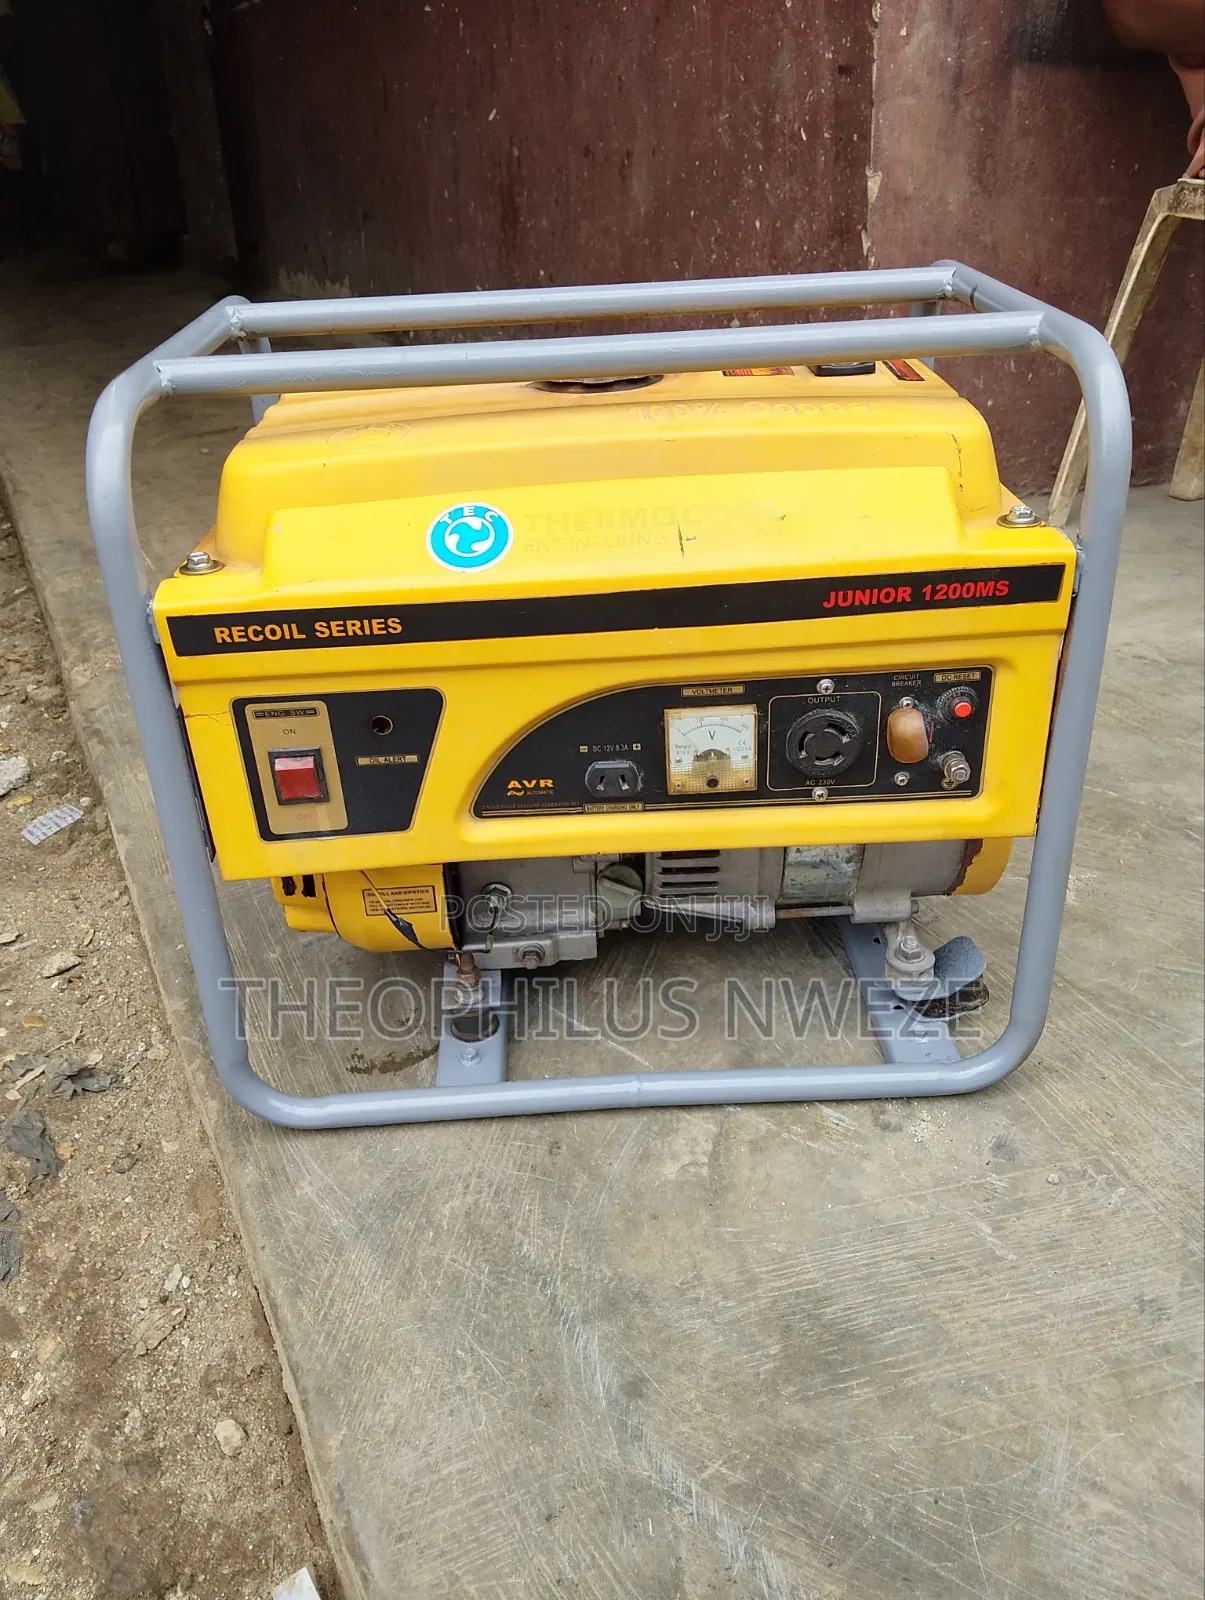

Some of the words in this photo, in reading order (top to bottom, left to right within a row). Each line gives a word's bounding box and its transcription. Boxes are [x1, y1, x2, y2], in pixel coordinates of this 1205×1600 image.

[439, 505, 499, 525] TEC
[822, 586, 912, 608] JUNIOR
[921, 580, 1010, 600] 1200MS
[213, 623, 306, 643] RECOIL
[314, 618, 402, 638] SERIES
[893, 673, 920, 681] CIRCUIT
[953, 672, 975, 680] RESET
[891, 680, 922, 688] BREAKER
[691, 687, 733, 695] VOLTMETER
[807, 696, 841, 704] OUTPUT
[265, 710, 285, 718] ENG
[282, 728, 297, 736] ON
[708, 730, 716, 740] V
[604, 744, 614, 752] 12V
[384, 755, 407, 763] ALERT
[507, 779, 554, 789] AVR
